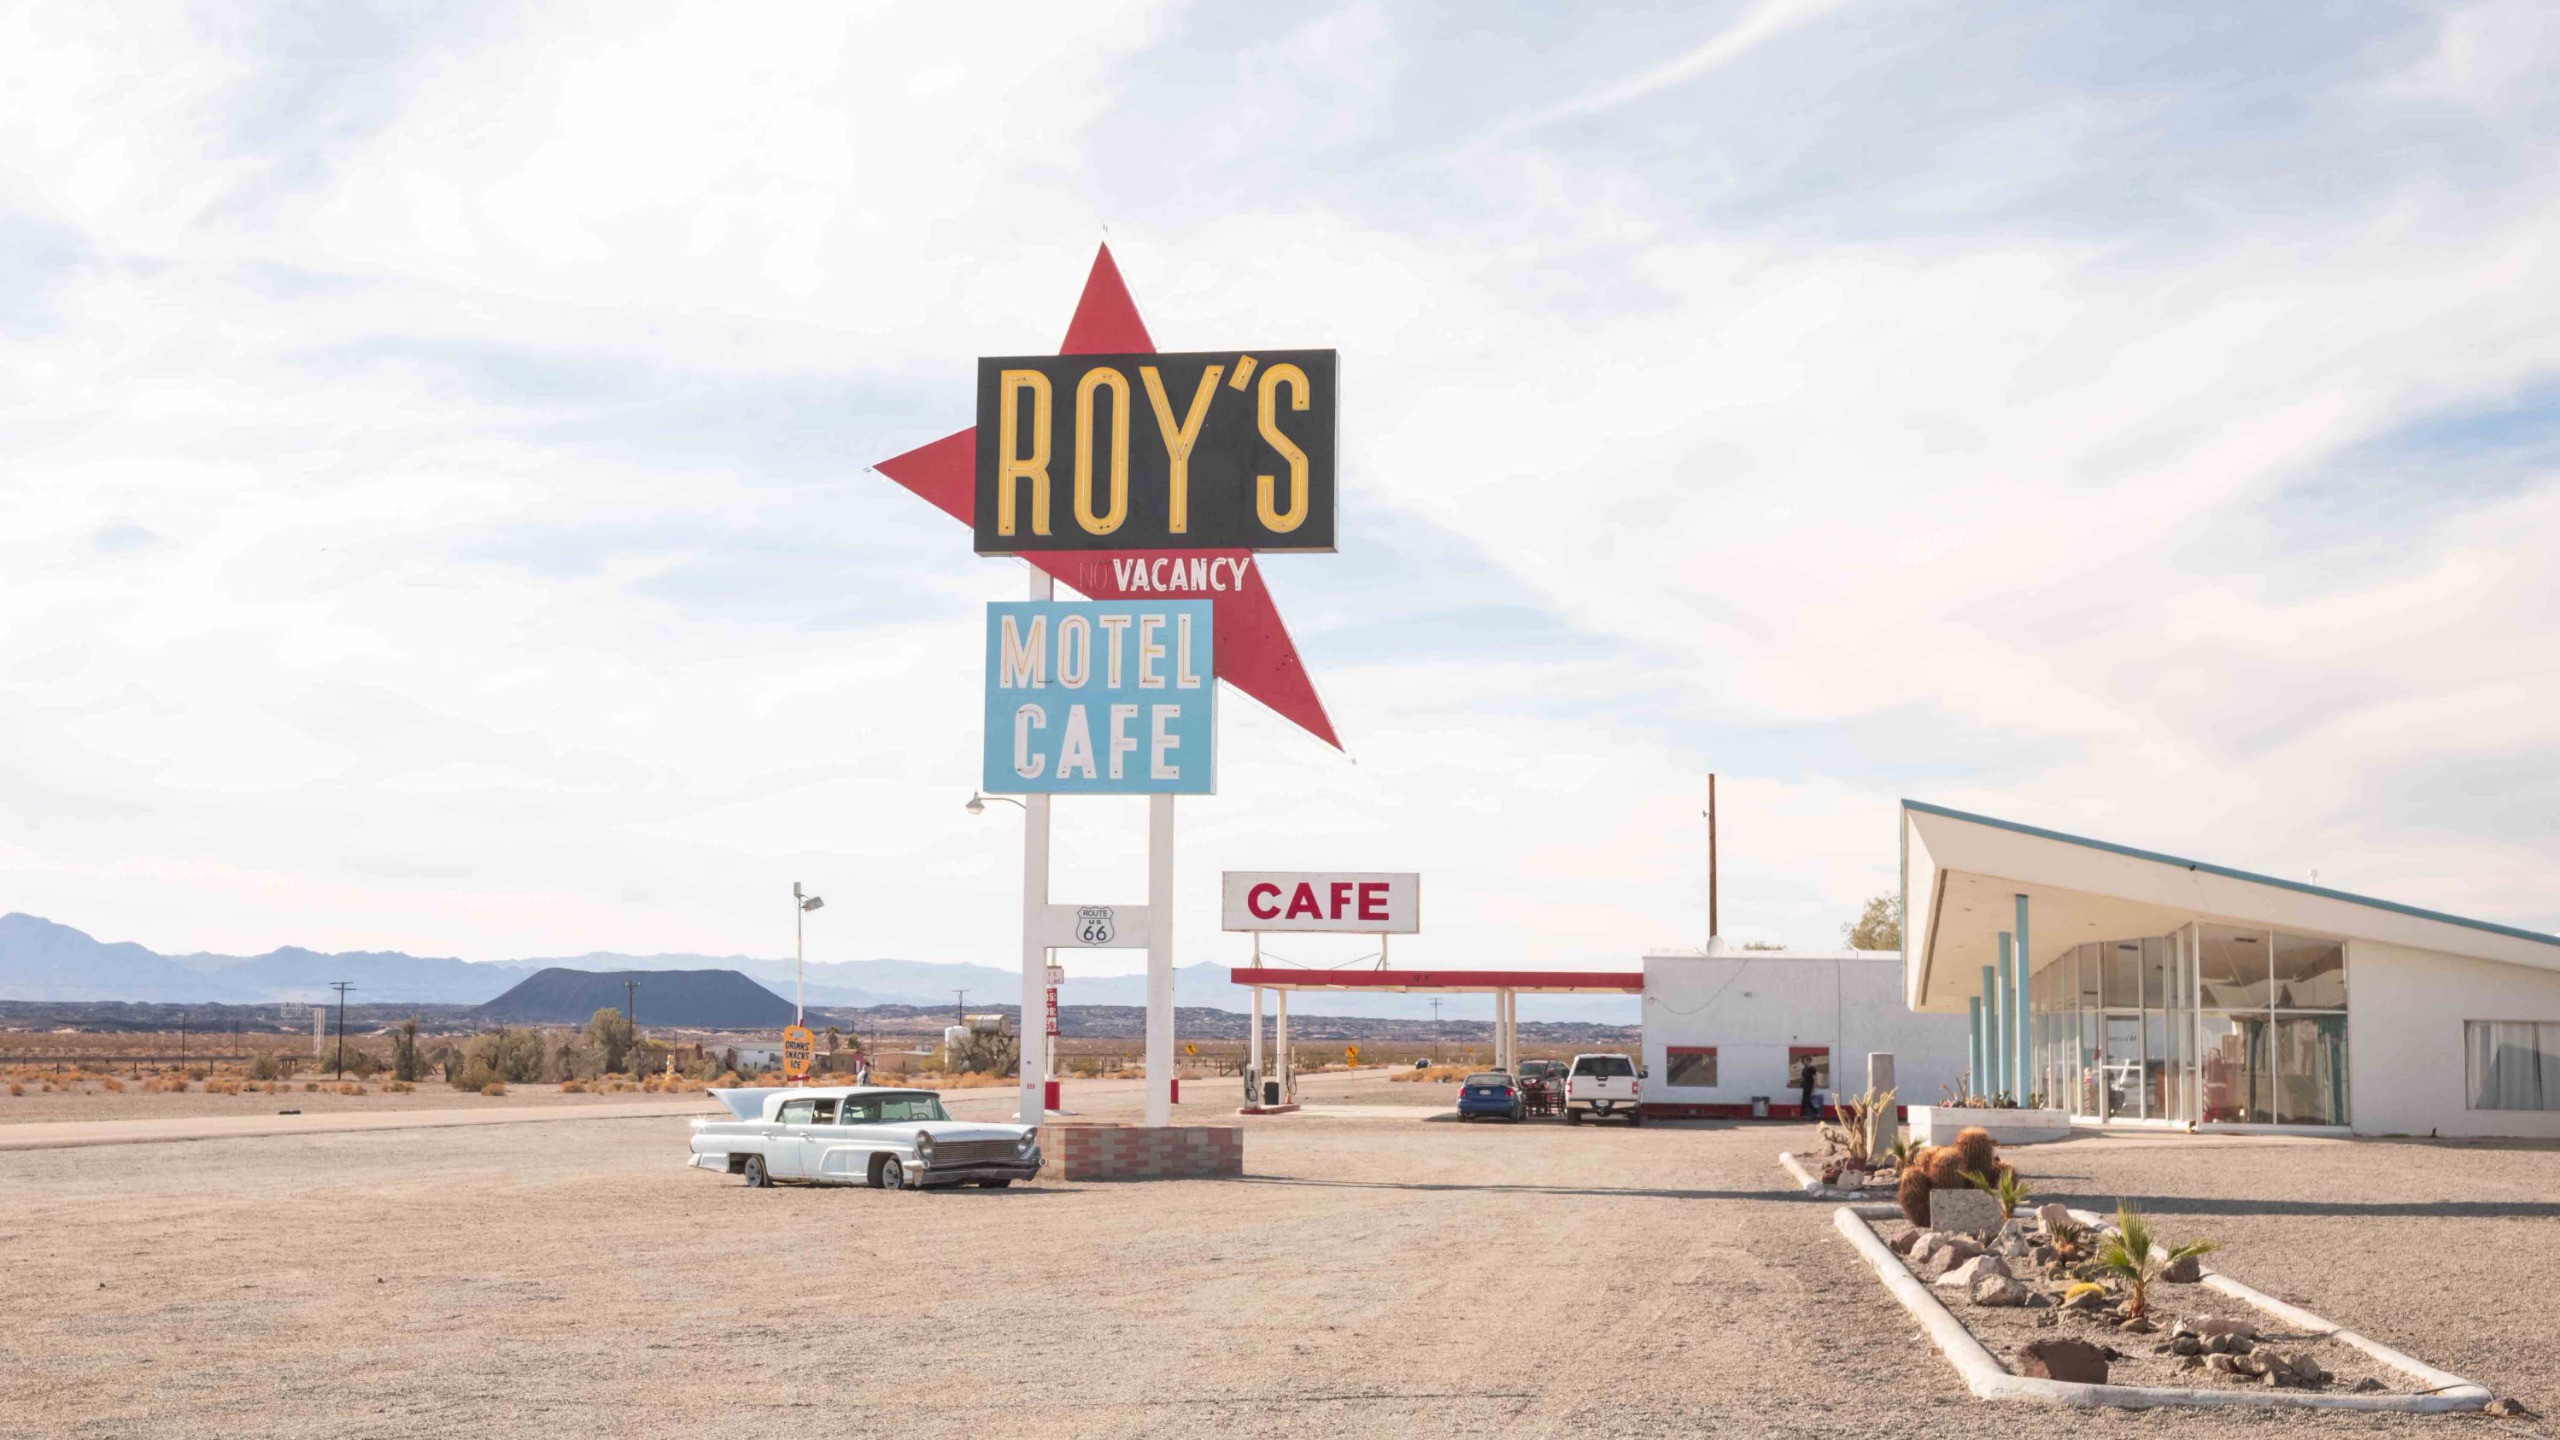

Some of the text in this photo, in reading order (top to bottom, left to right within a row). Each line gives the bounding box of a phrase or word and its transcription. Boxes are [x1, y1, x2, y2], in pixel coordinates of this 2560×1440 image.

[998, 354, 1309, 536] ROY'S
[1113, 557, 1250, 592] VACANCY
[1000, 614, 1200, 689] MOTEL
[1014, 703, 1181, 780] CAFE
[1083, 909, 1107, 917] ROUTE
[1247, 882, 1390, 921] CAFE
[1083, 925, 1107, 941] 66
[785, 1041, 810, 1050] DRINKS
[785, 1051, 810, 1060] SNACKS
[790, 1060, 801, 1069] ICE
